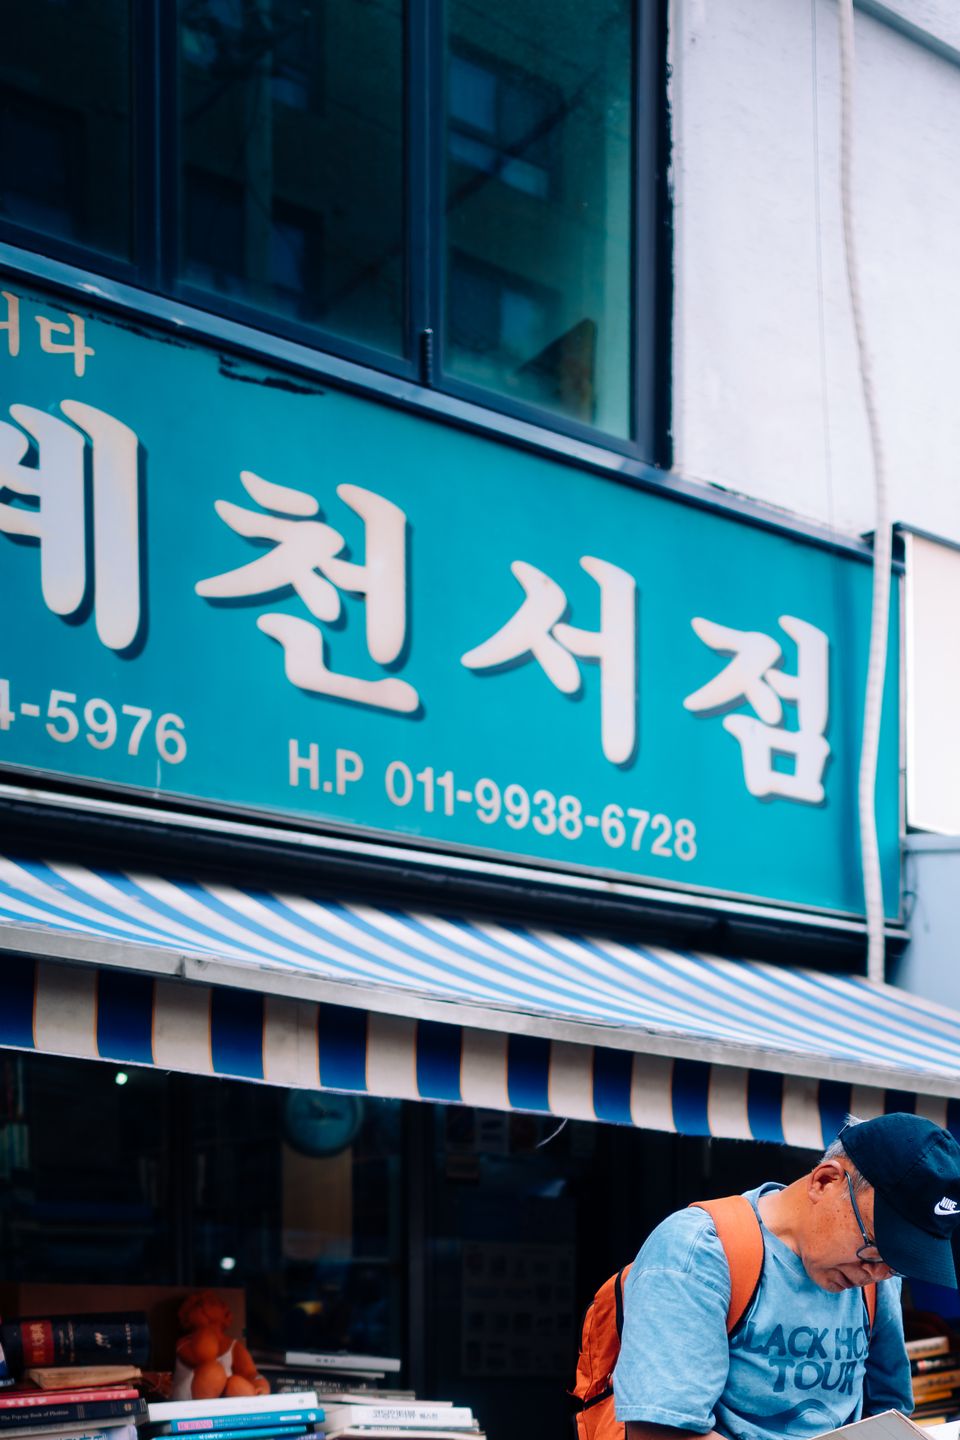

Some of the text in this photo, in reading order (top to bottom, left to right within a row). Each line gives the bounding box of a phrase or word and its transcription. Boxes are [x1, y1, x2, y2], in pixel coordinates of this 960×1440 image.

[288, 738, 698, 862] H.P 011-9938-6728
[939, 1196, 958, 1212] NIKE
